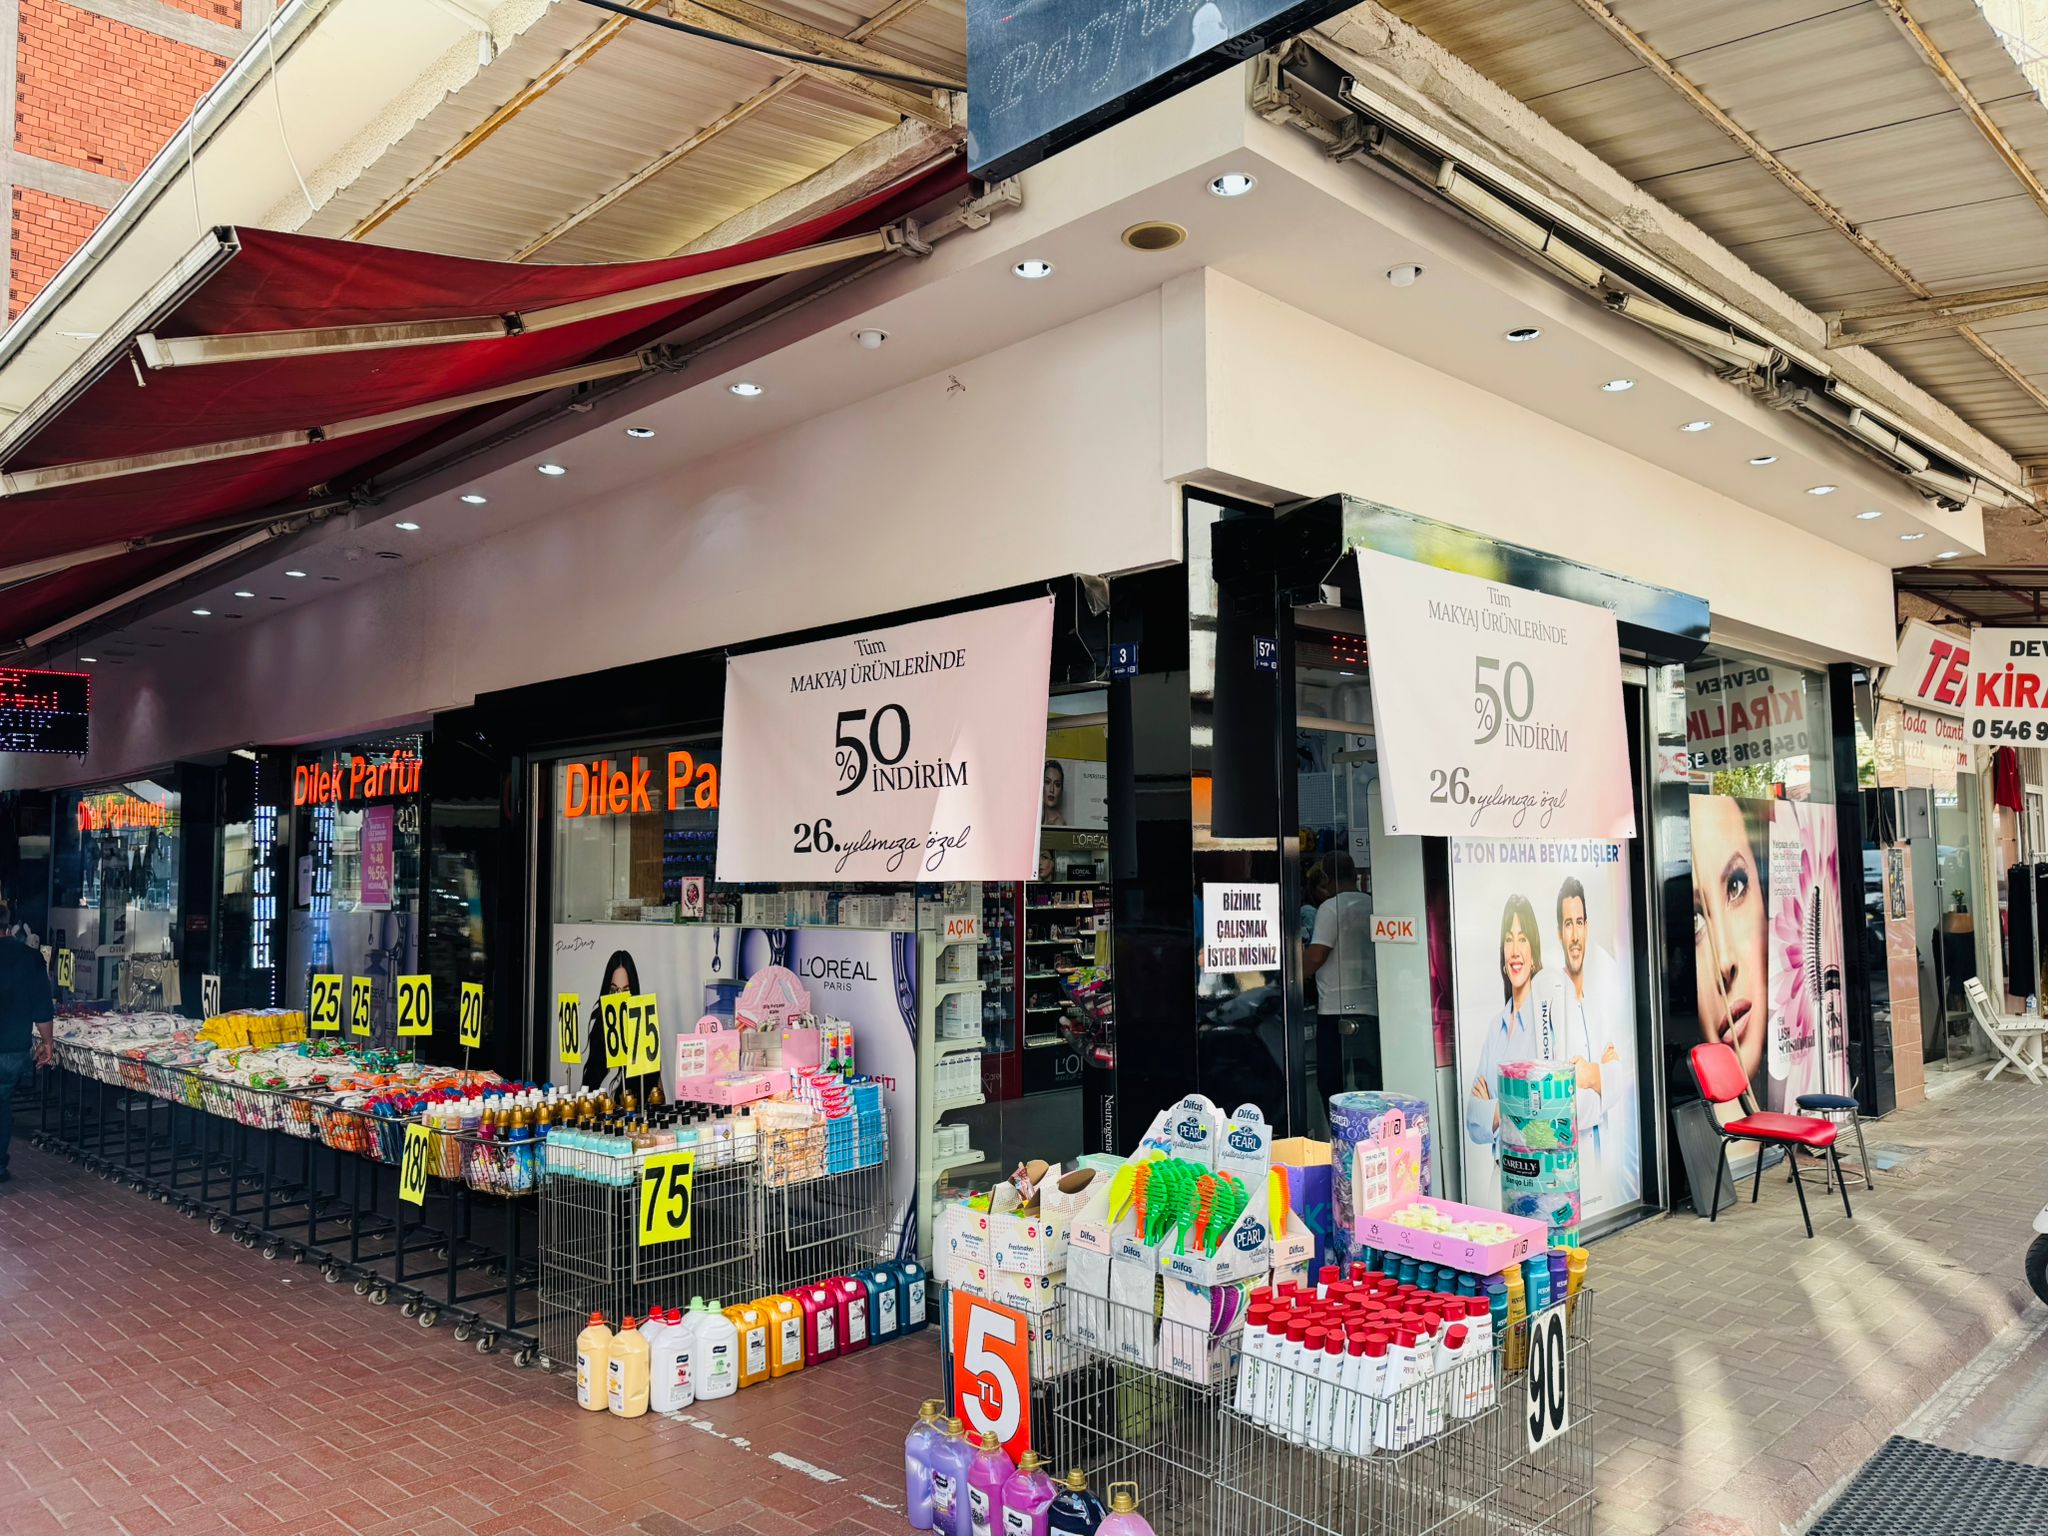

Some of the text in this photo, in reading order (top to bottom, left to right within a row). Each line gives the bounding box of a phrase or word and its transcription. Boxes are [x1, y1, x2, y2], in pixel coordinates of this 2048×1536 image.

[1486, 586, 1512, 608] Tüm
[1428, 599, 1568, 646] MAKYAJ ÜRÜNLERİNDE
[854, 638, 886, 656] Tüm
[1119, 649, 1127, 663] 3
[790, 649, 966, 693] MAKYAJ ÜRÜNLERİNDE
[1918, 638, 1970, 708] TE
[1505, 718, 1568, 752] İNDİRİM
[1972, 719, 1986, 739] 0
[1990, 720, 2031, 740] 546
[294, 759, 344, 806] Dilek
[564, 750, 719, 818] Dilek Pa
[872, 758, 969, 792] İNDİRİM
[1430, 767, 1476, 805] 26.
[1540, 788, 1568, 829] özel
[77, 799, 103, 832] Dilek
[793, 818, 971, 873] 26. yılımıza özel
[1454, 843, 1462, 863] 2
[1466, 843, 1495, 864] TON
[1500, 843, 1536, 864] DAHA
[1540, 843, 1578, 864] BEYAZ
[1223, 889, 1261, 911] BİZİMLE
[947, 919, 974, 938] AÇIK
[1217, 919, 1268, 943] ÇALIŞMAK
[1375, 920, 1413, 940] AÇIK
[58, 954, 70, 981] 75
[800, 956, 877, 981] L'ORÉAL
[1207, 943, 1277, 967] İSTER MİSİNİZ
[203, 979, 219, 1018] 50
[313, 981, 340, 1023] 25
[353, 983, 370, 1027] 25
[400, 982, 430, 1027] 20
[461, 990, 480, 1038] 20
[558, 1002, 579, 1054] 180
[628, 1004, 660, 1064] 75
[1055, 1054, 1083, 1075] L'O
[1104, 1094, 1114, 1153] Neutrogena
[1180, 1125, 1204, 1140] PEARL
[1231, 1136, 1258, 1150] PEARL
[404, 1133, 428, 1193] 180
[1503, 1158, 1537, 1171] CARELLY
[644, 1163, 690, 1232] 75
[1237, 1229, 1262, 1247] PEARL
[961, 1303, 1021, 1444] 5
[1529, 1312, 1565, 1442] 90
[977, 1380, 1000, 1407] TL
